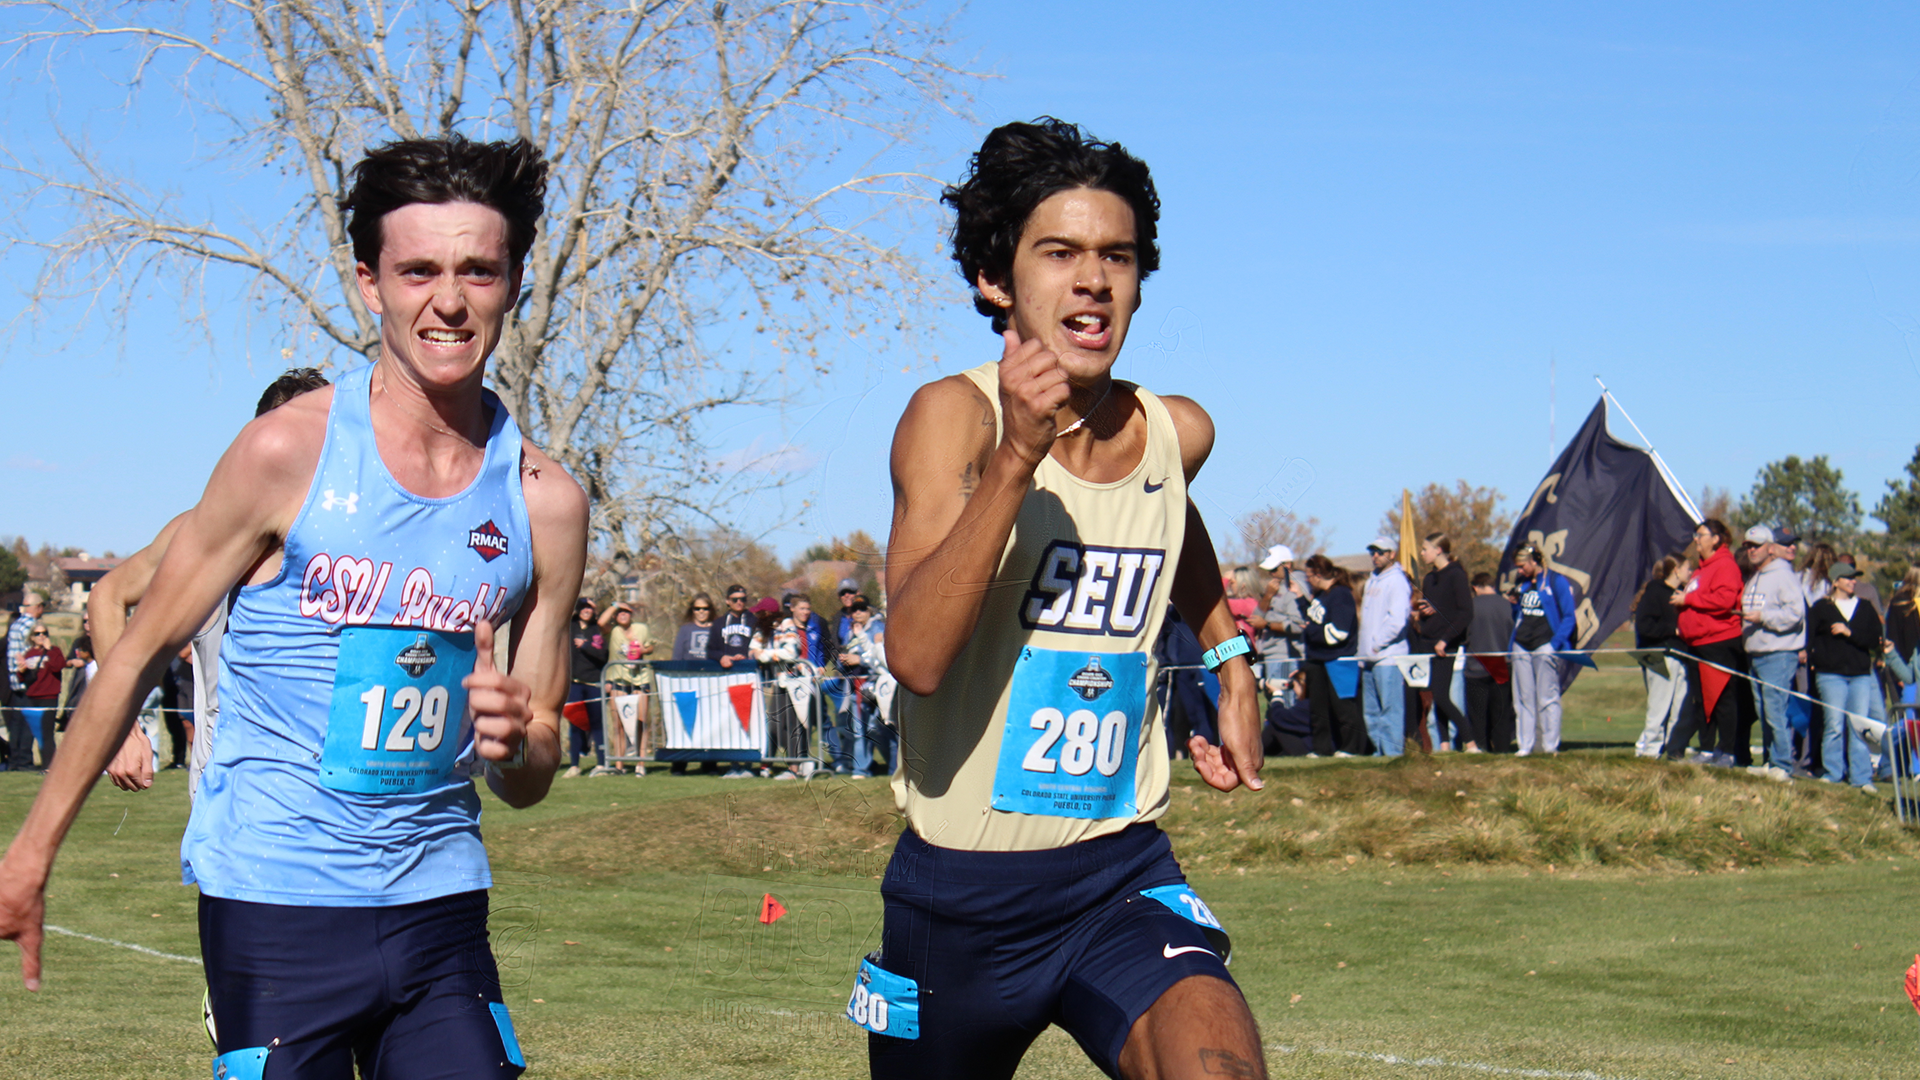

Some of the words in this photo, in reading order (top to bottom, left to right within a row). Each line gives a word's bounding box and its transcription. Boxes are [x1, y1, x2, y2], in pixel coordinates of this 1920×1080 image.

[470, 532, 508, 553] RMAC
[300, 552, 393, 625] CSU
[1019, 539, 1166, 637] SEU
[360, 684, 449, 752] 129
[1022, 707, 1127, 777] 280
[349, 767, 379, 776] COLORADO
[380, 769, 395, 777] STATE
[396, 769, 424, 777] UNIVERSITY
[380, 778, 406, 787] PUEBLO,
[407, 778, 416, 786] CO
[1021, 789, 1052, 799] COLORADO
[1053, 792, 1068, 800] STATE
[1053, 801, 1081, 811] PUEBLO,
